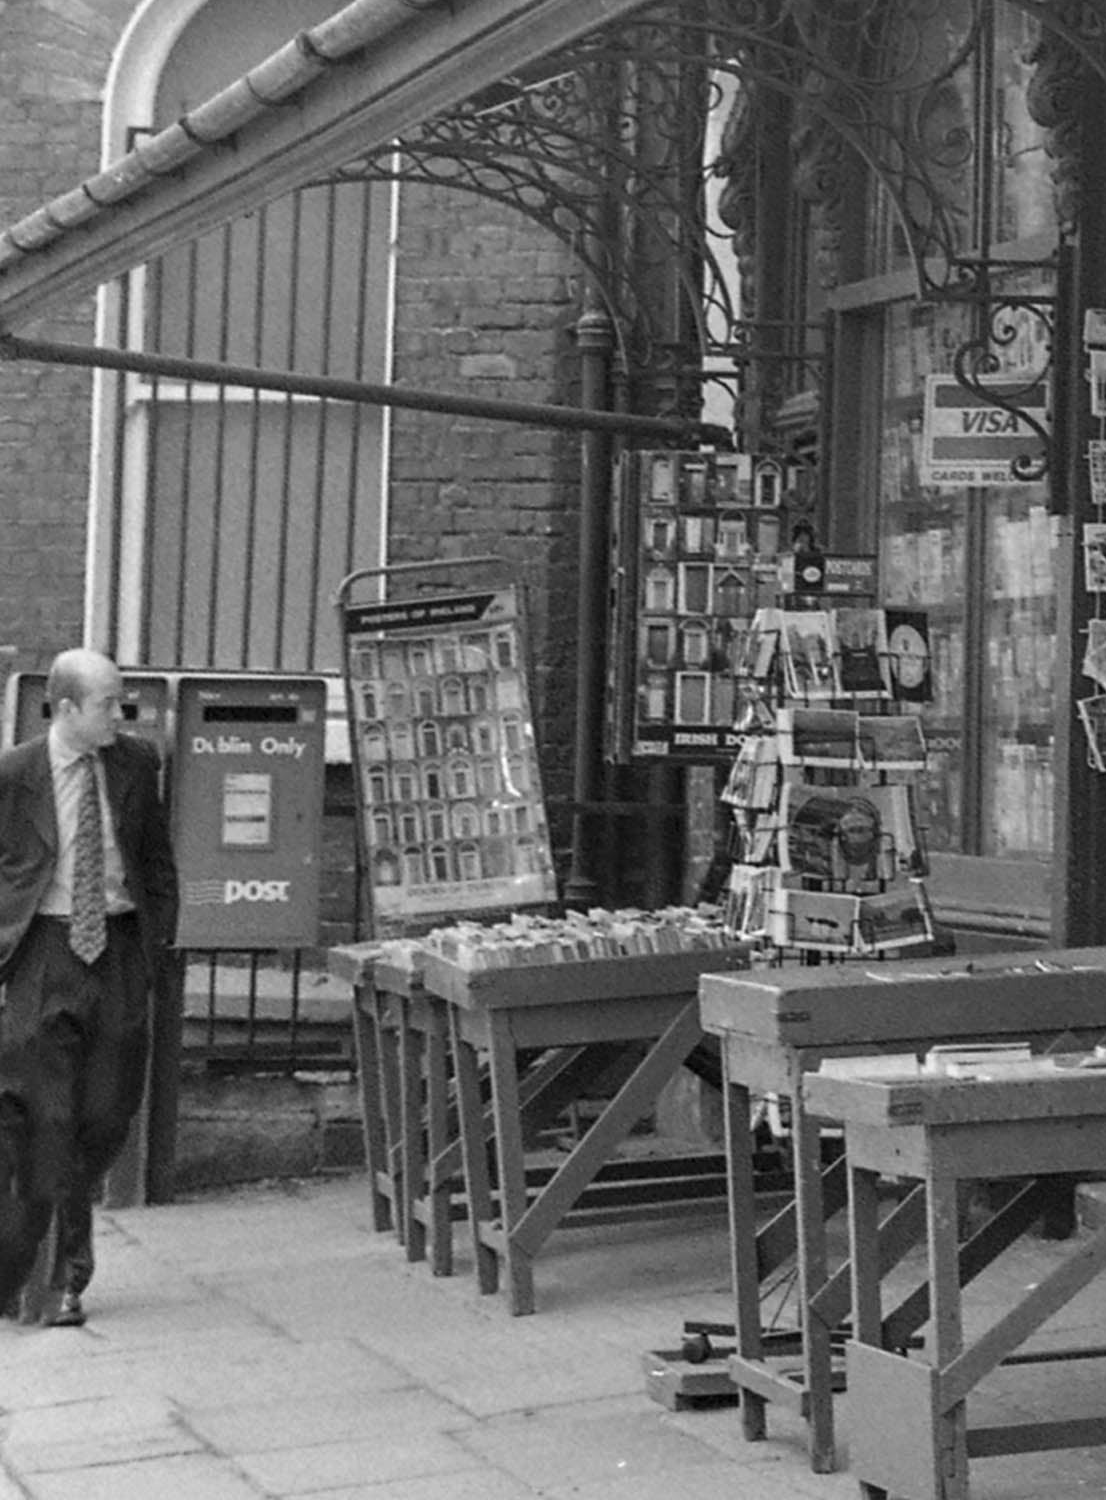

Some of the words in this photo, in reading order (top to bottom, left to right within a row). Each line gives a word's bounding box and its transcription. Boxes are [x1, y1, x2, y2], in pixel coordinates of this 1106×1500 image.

[962, 410, 1019, 433] VISA
[260, 736, 306, 759] Only
[674, 733, 718, 746] IRISH
